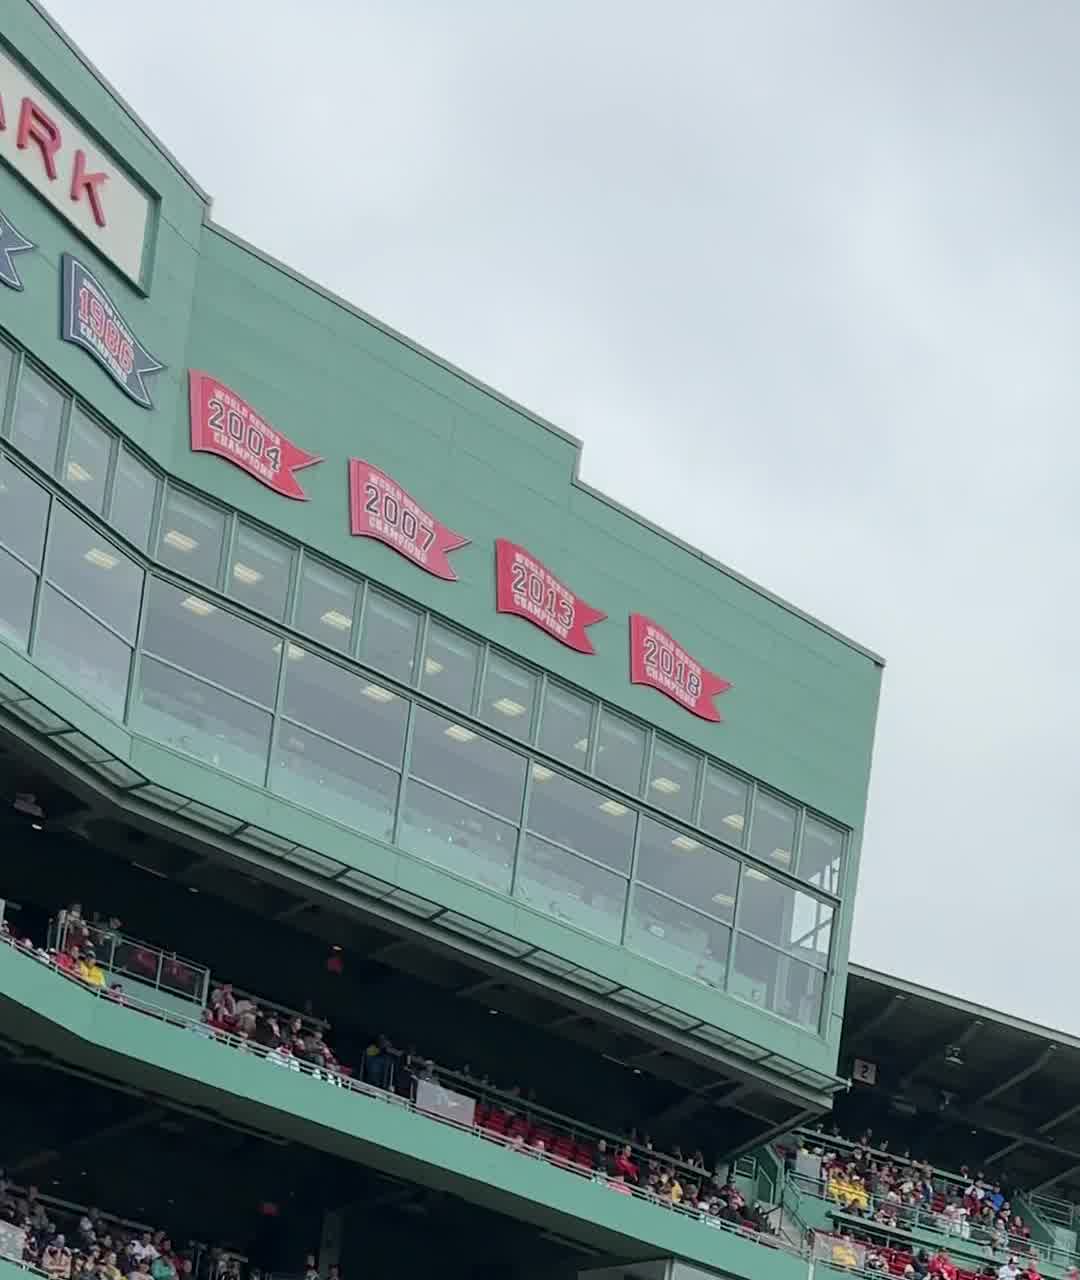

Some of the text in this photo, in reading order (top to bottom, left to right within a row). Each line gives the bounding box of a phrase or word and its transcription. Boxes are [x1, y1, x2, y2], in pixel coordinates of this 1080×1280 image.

[0, 96, 110, 227] RK
[79, 287, 135, 374] 1986
[208, 398, 281, 473] 2004
[364, 481, 436, 553] 2007
[512, 562, 575, 630] 2013
[644, 635, 702, 698] 2018
